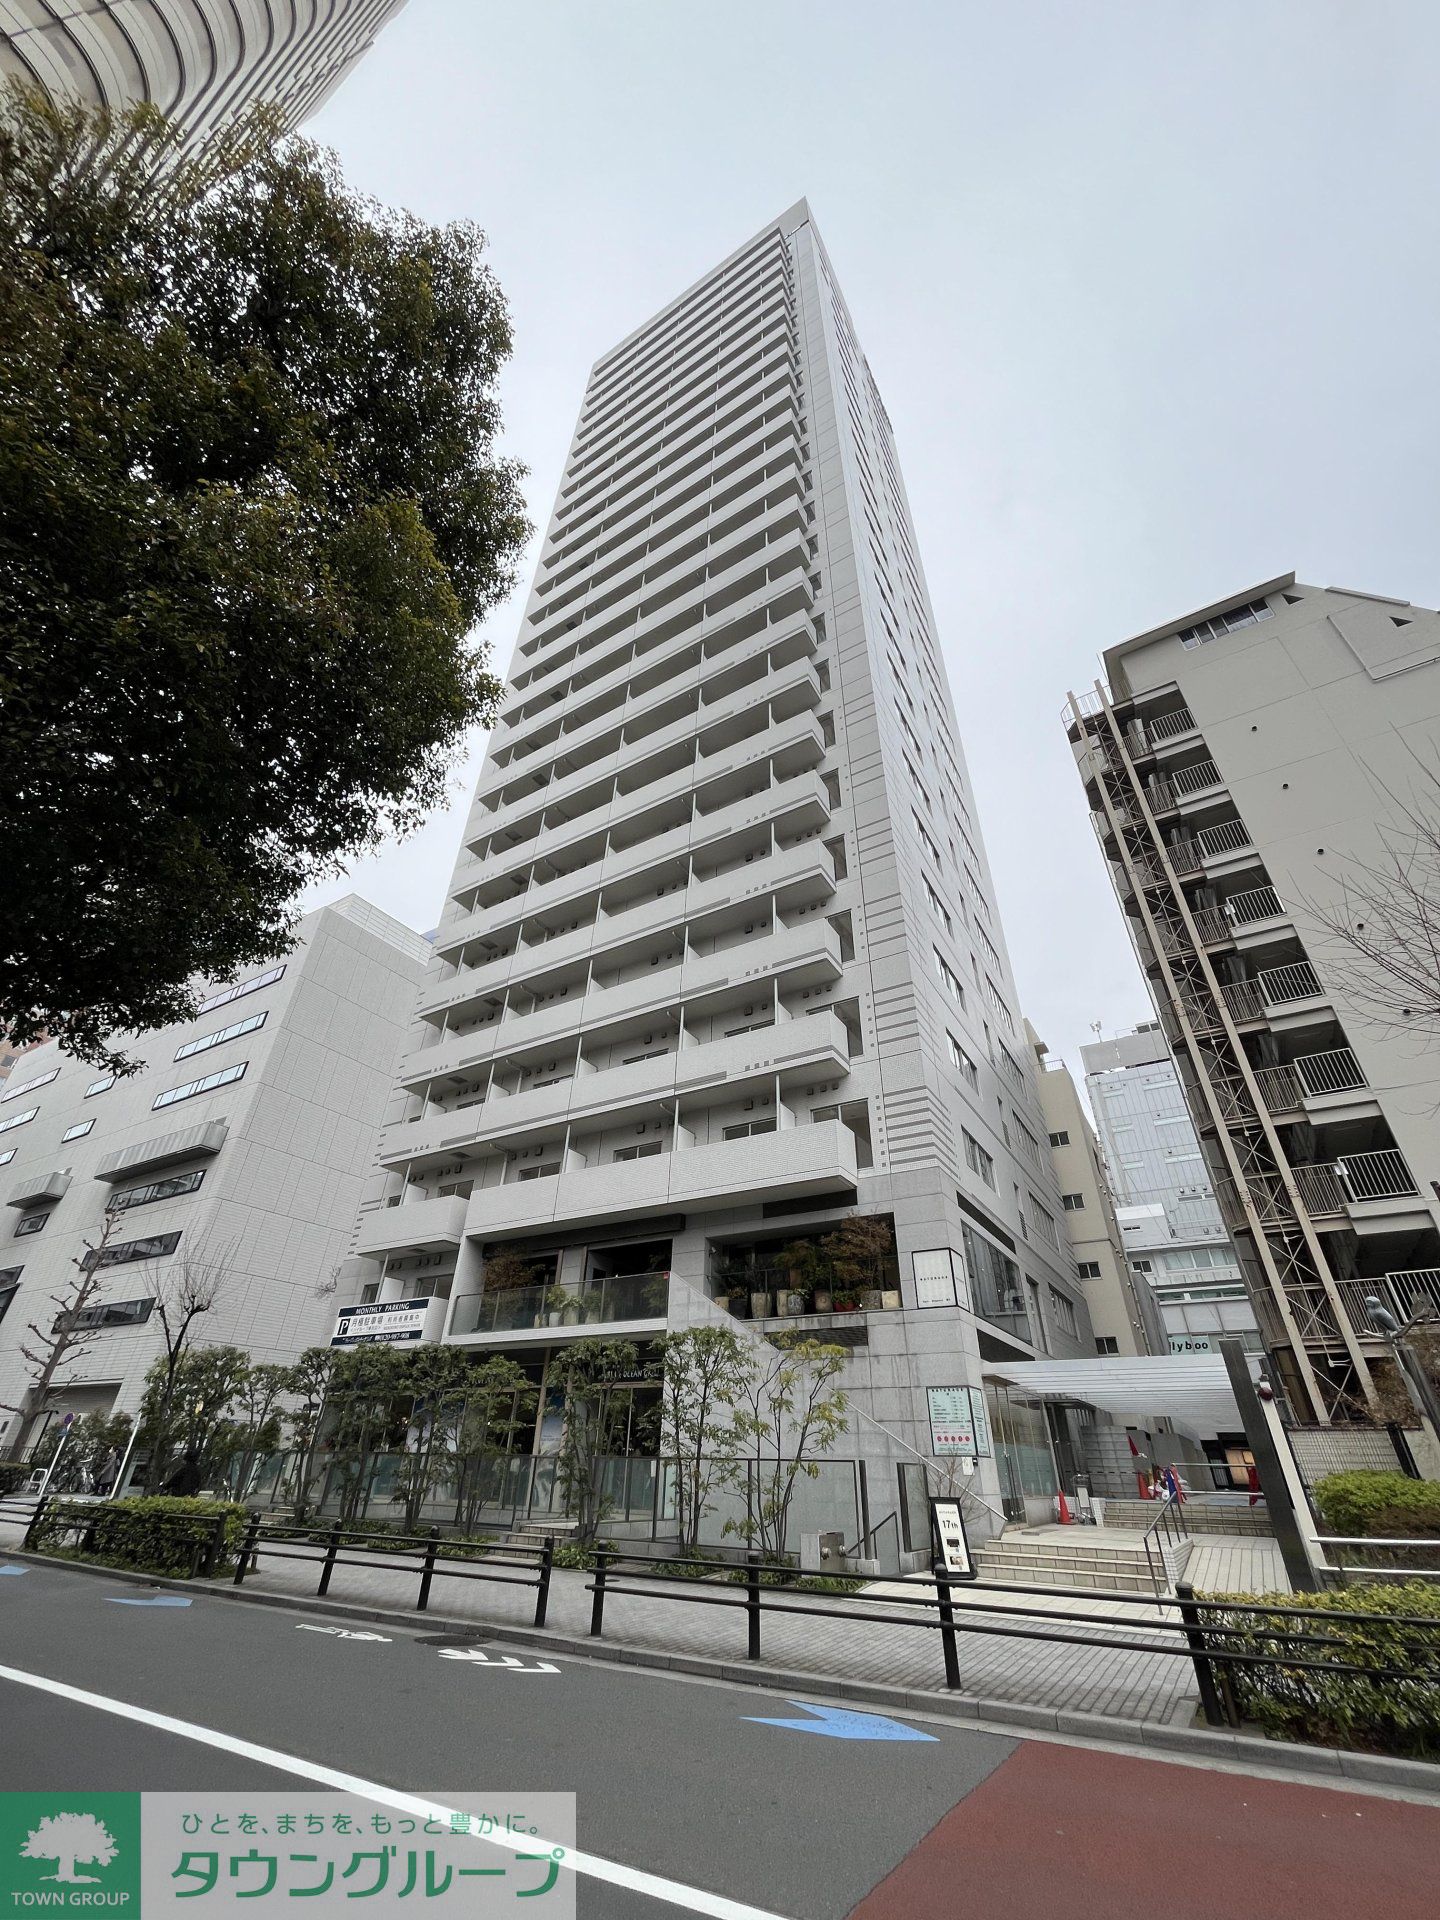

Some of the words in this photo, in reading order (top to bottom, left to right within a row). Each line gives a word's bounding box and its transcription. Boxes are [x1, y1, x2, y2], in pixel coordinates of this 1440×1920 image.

[355, 1305, 383, 1315] MONTHLY
[385, 1302, 410, 1312] PARKING
[352, 1315, 384, 1326] 月極駐車場
[340, 1320, 349, 1335] P
[942, 1520, 958, 1529] 17th
